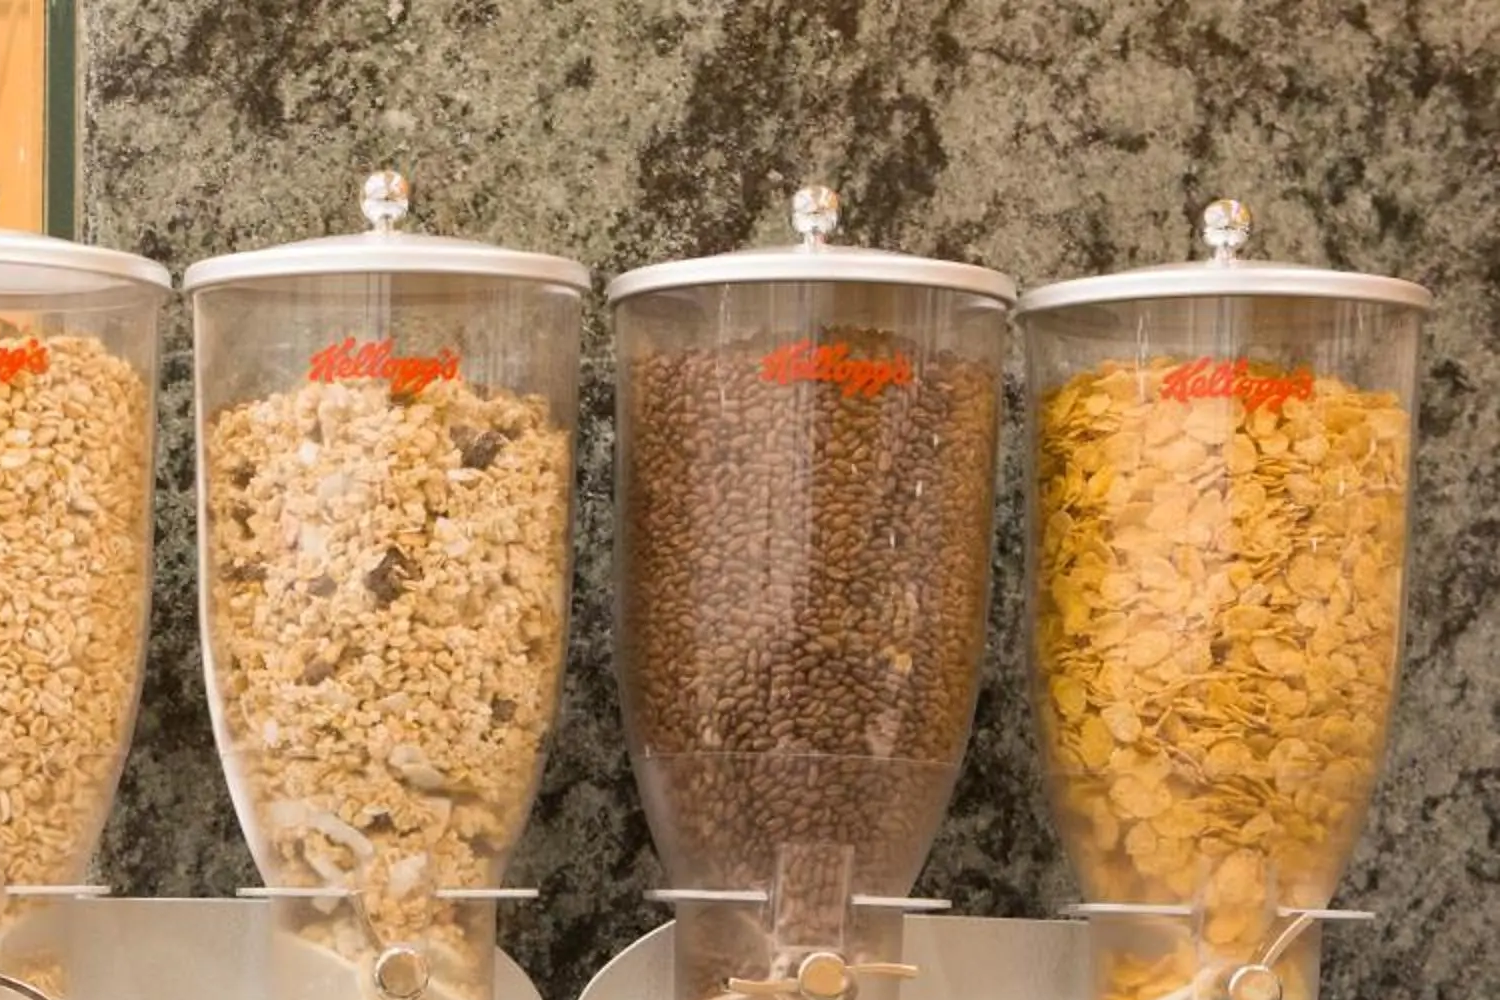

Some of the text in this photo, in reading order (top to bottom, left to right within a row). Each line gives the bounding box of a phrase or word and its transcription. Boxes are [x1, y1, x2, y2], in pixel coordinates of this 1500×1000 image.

[309, 336, 460, 394] Kellogg's
[758, 336, 912, 398] Kellogg's
[1160, 355, 1315, 414] Kellogg's
